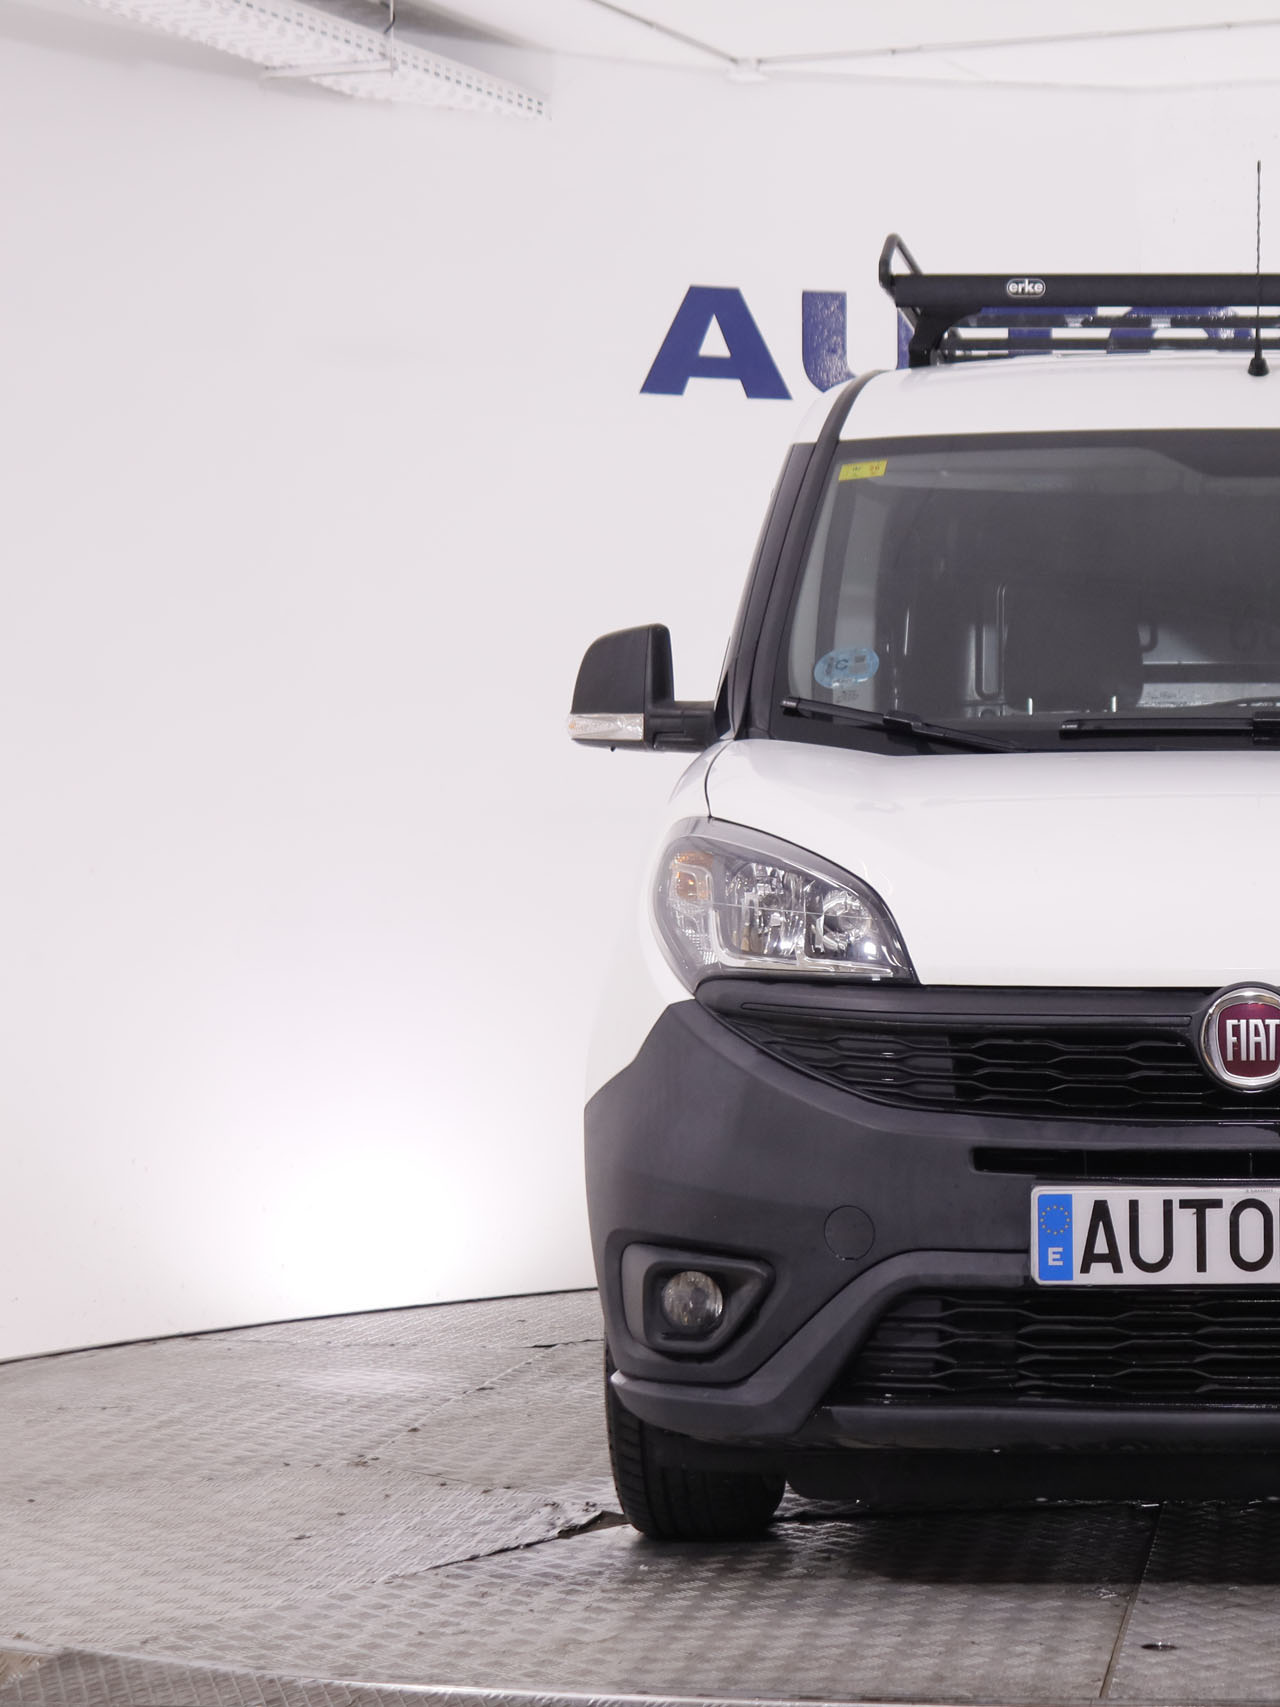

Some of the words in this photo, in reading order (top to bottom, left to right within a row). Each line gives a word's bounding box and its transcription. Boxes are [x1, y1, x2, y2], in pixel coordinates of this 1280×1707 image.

[1009, 279, 1043, 294] erke
[1225, 1018, 1280, 1062] FIAT
[1047, 1247, 1063, 1266] E
